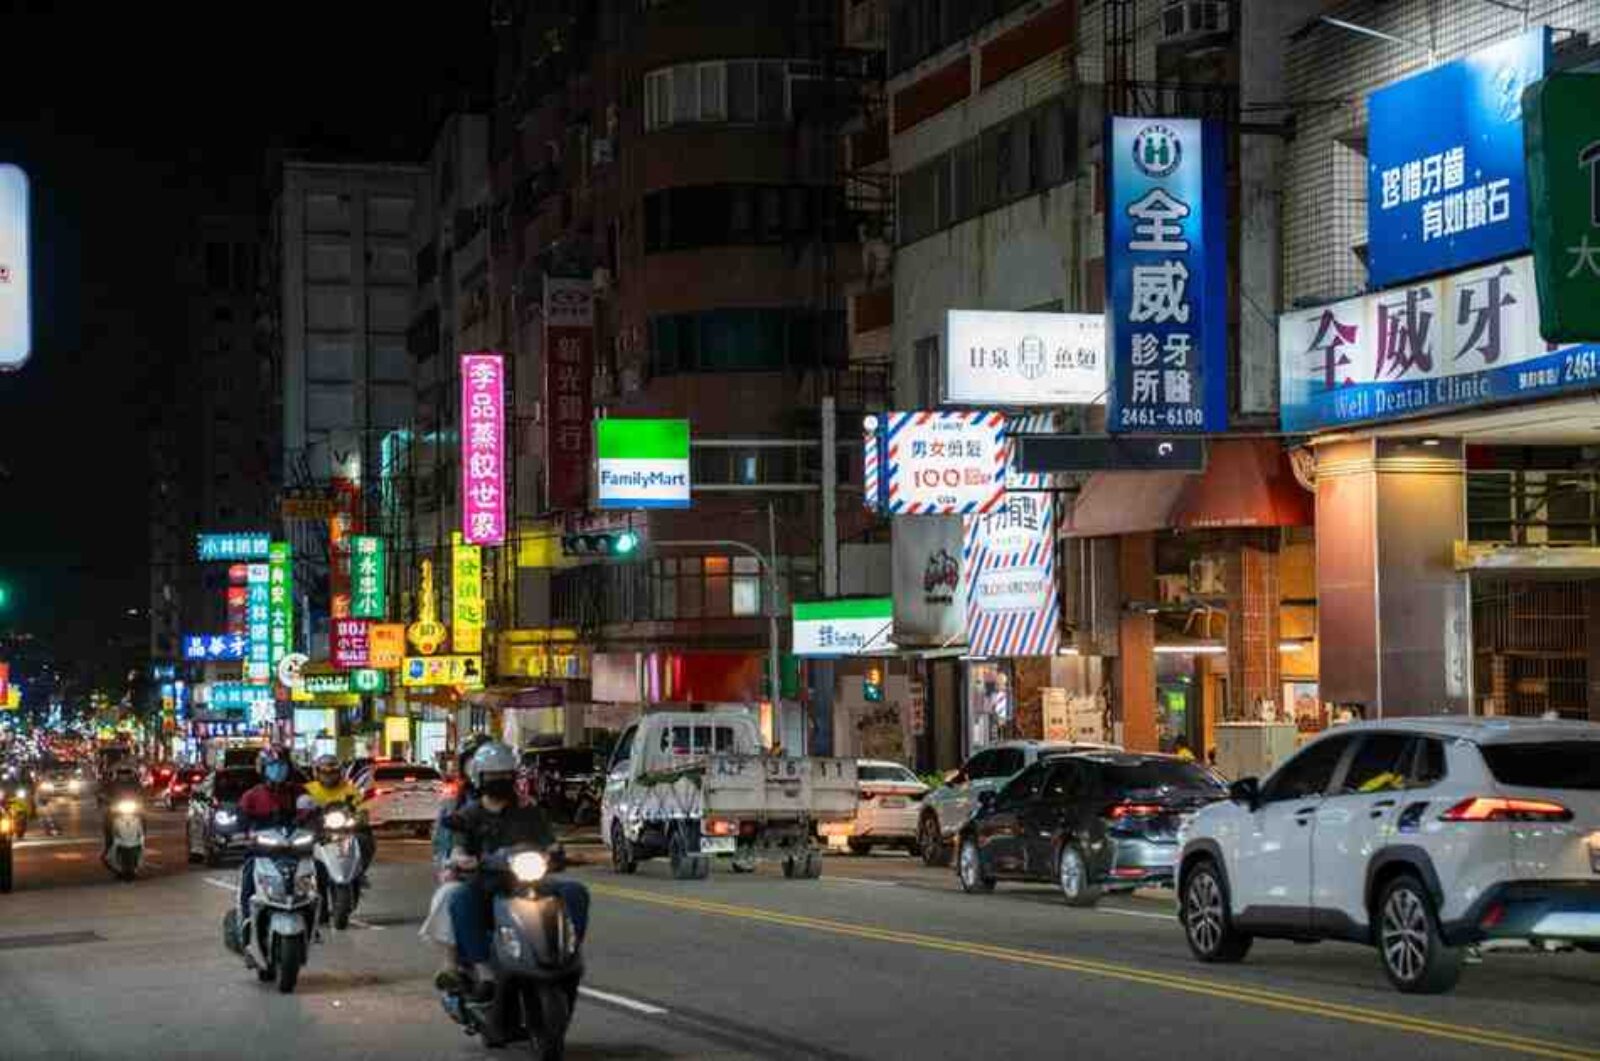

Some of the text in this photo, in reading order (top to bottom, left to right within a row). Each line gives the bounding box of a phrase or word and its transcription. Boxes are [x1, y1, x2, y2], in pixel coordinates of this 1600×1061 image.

[1381, 146, 1464, 209] 珍惜牙齒
[1423, 178, 1510, 242] 有如鑽石
[1128, 187, 1190, 324] 全威
[1121, 407, 1204, 425] 2461-6100
[1334, 376, 1490, 419] Well Dental Clinic
[601, 471, 686, 488] FamilyMart
